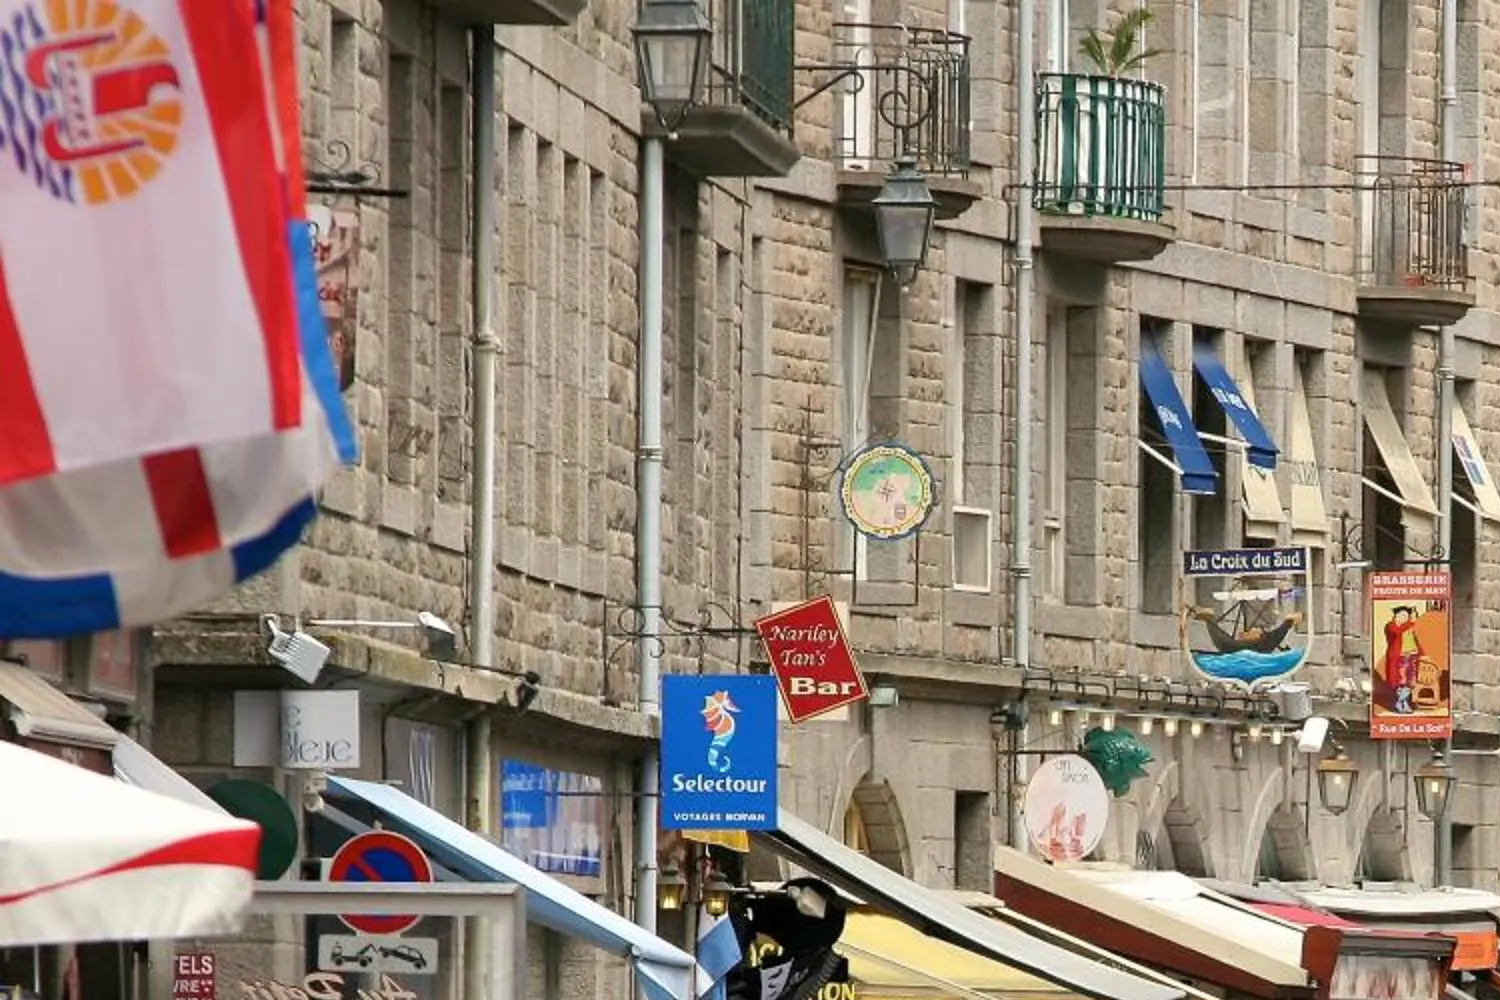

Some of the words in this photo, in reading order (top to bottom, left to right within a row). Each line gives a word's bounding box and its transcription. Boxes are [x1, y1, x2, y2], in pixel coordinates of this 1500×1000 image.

[1190, 553, 1208, 571] La
[1211, 553, 1249, 569] Croix
[1252, 552, 1271, 567] du
[1273, 551, 1301, 567] Sud
[768, 623, 839, 649] Nariley
[780, 648, 827, 667] Tan's
[790, 676, 857, 696] Bar
[673, 773, 767, 793] Selectour
